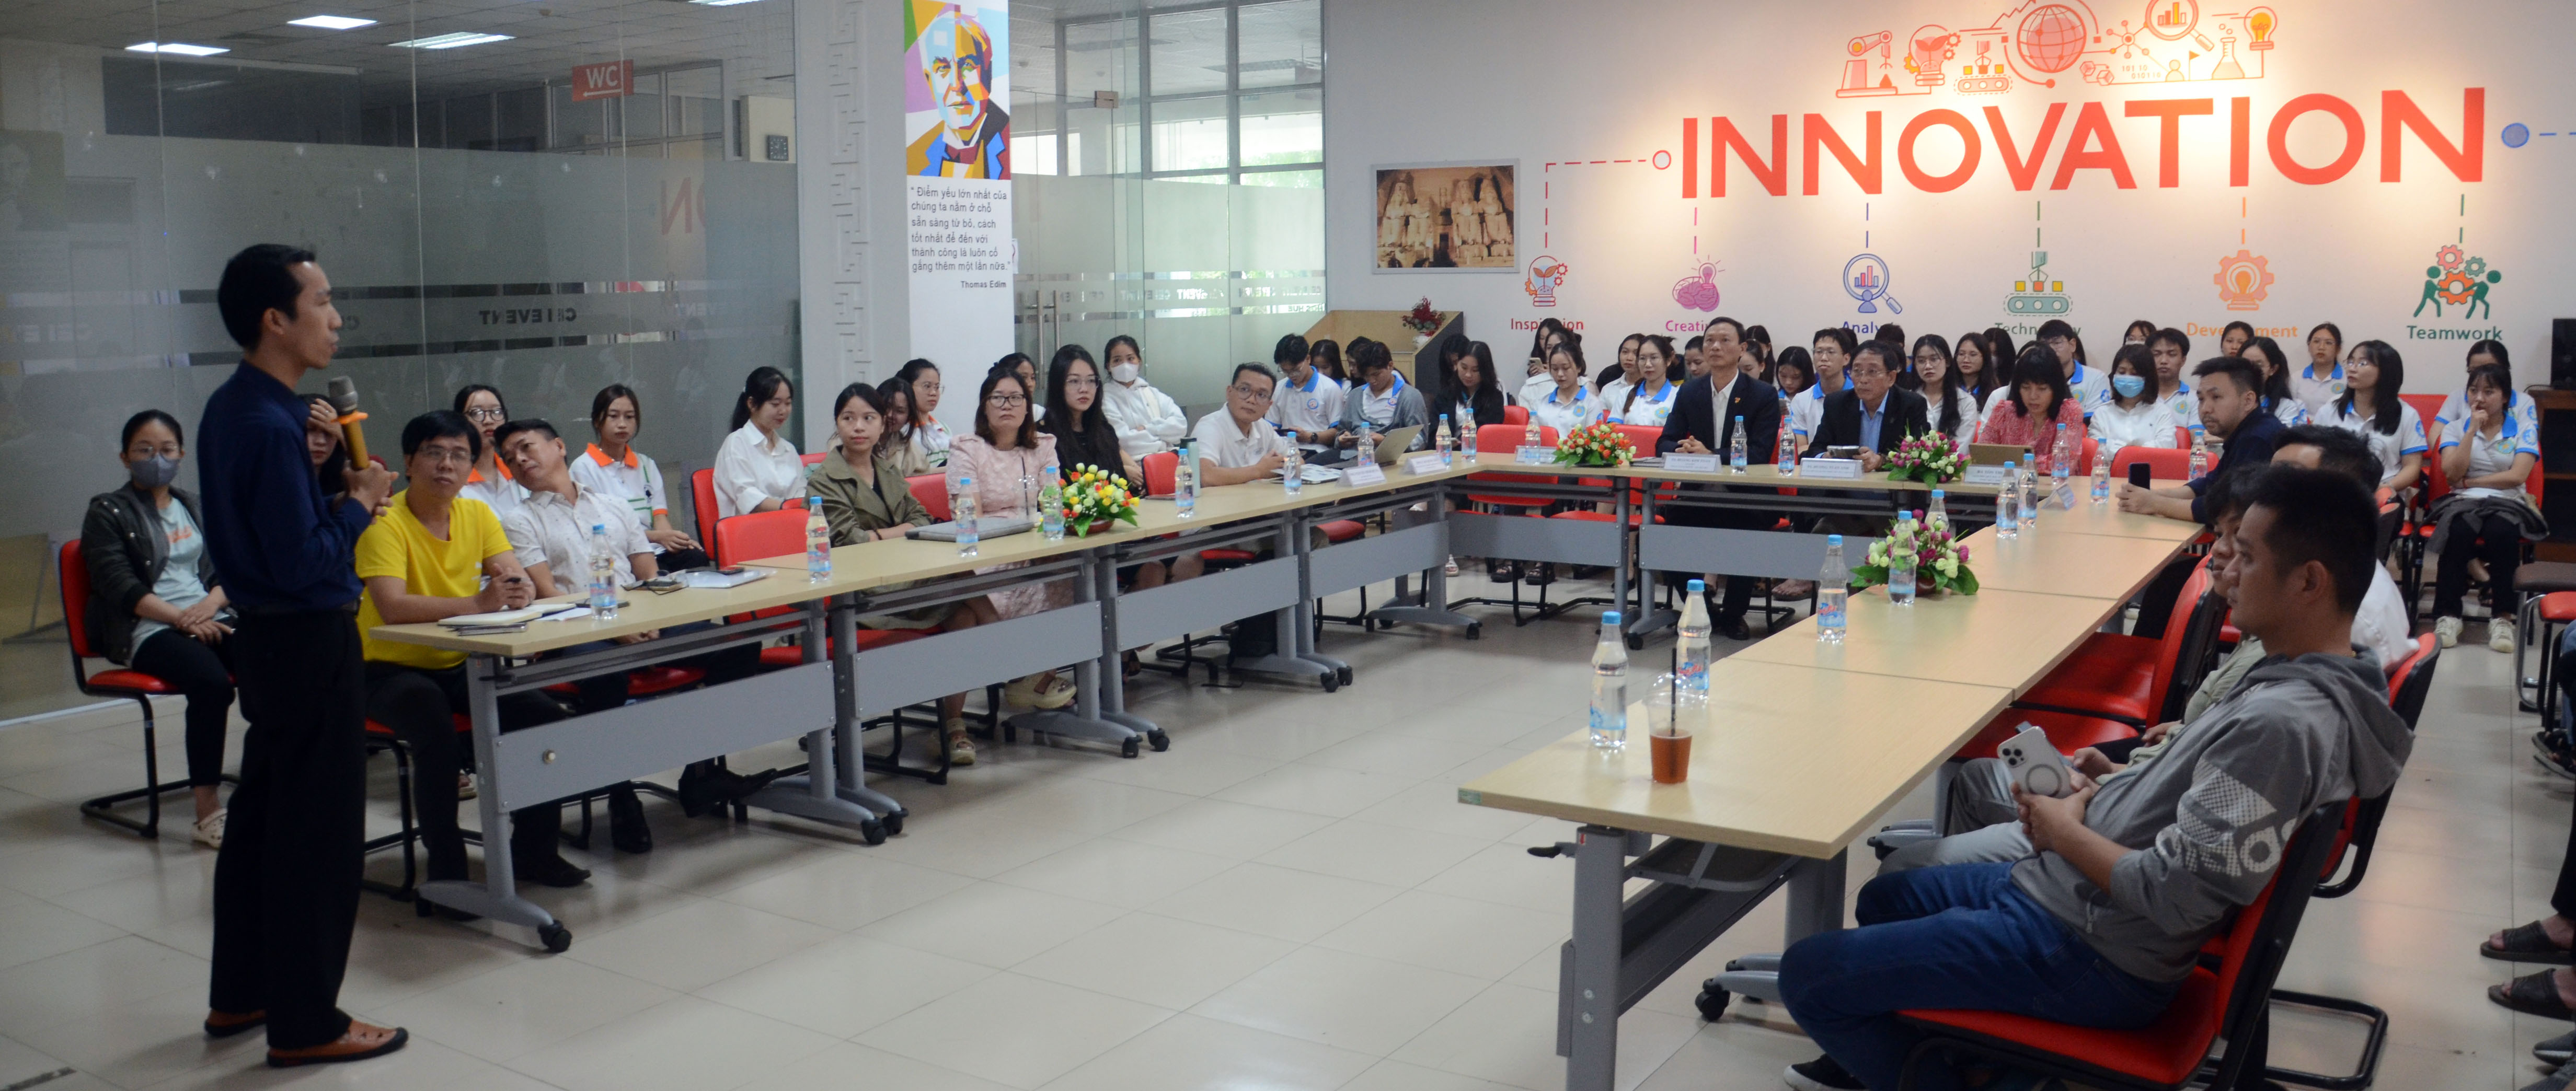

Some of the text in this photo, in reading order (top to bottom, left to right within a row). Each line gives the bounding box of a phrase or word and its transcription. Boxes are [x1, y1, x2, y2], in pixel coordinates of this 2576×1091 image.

[586, 65, 618, 88] WC
[1682, 87, 2485, 199] INNOVATION
[917, 185, 938, 197] Điểm
[941, 187, 956, 200] yếu
[958, 189, 971, 198] lớn
[973, 188, 991, 199] nhất
[993, 190, 1007, 200] của
[911, 201, 936, 213] chúng
[970, 203, 975, 212] ở
[951, 218, 961, 227] từ
[978, 219, 996, 228] cách
[912, 231, 988, 243] tốt nhất để đến với
[912, 246, 998, 259] thành công là luôn cố
[912, 259, 933, 273] gắng
[935, 261, 956, 271] thêm
[958, 262, 973, 272] một
[975, 260, 987, 271] lần
[1511, 318, 1584, 332] Inspion
[1995, 322, 2081, 335] Techny
[2187, 322, 2298, 338] Devement
[2407, 325, 2502, 340] Teamwork
